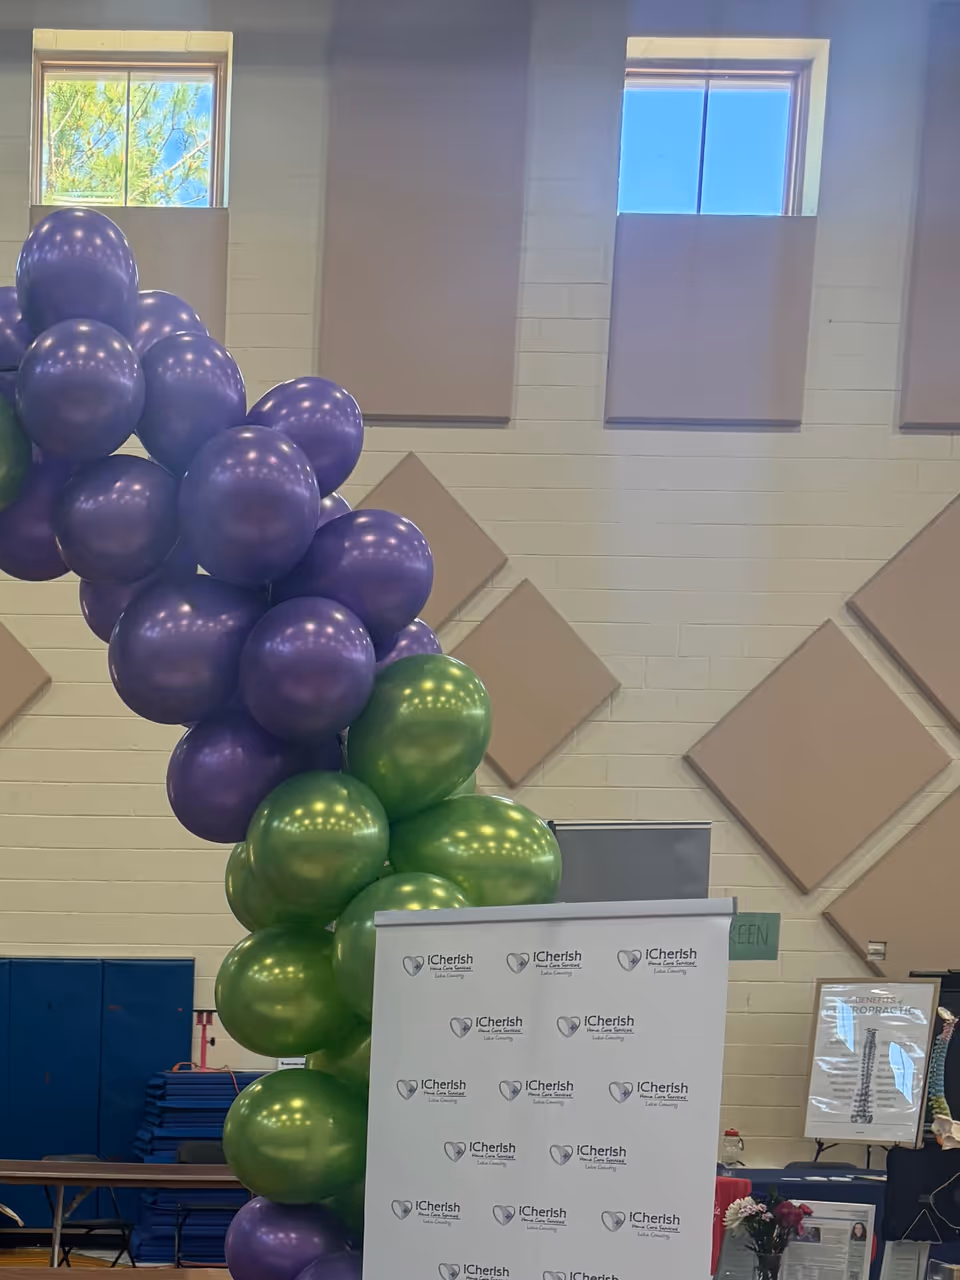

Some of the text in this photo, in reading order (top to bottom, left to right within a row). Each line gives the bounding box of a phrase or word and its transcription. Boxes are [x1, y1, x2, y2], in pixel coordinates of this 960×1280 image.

[428, 953, 473, 965] iCherish
[533, 950, 582, 962] iCherish
[646, 948, 697, 960] iCherish
[476, 1016, 523, 1027] iCherish
[584, 1015, 634, 1026] iCherish
[421, 1079, 466, 1090] iCherish
[526, 1080, 573, 1091] iCherish
[637, 1081, 688, 1094] iCherish
[469, 1141, 516, 1153] iCherish
[577, 1145, 626, 1157] iCherish
[416, 1200, 460, 1212] iCherish
[519, 1206, 566, 1218] iCherish
[630, 1212, 680, 1225] iCherish
[464, 1264, 509, 1276] iCherish
